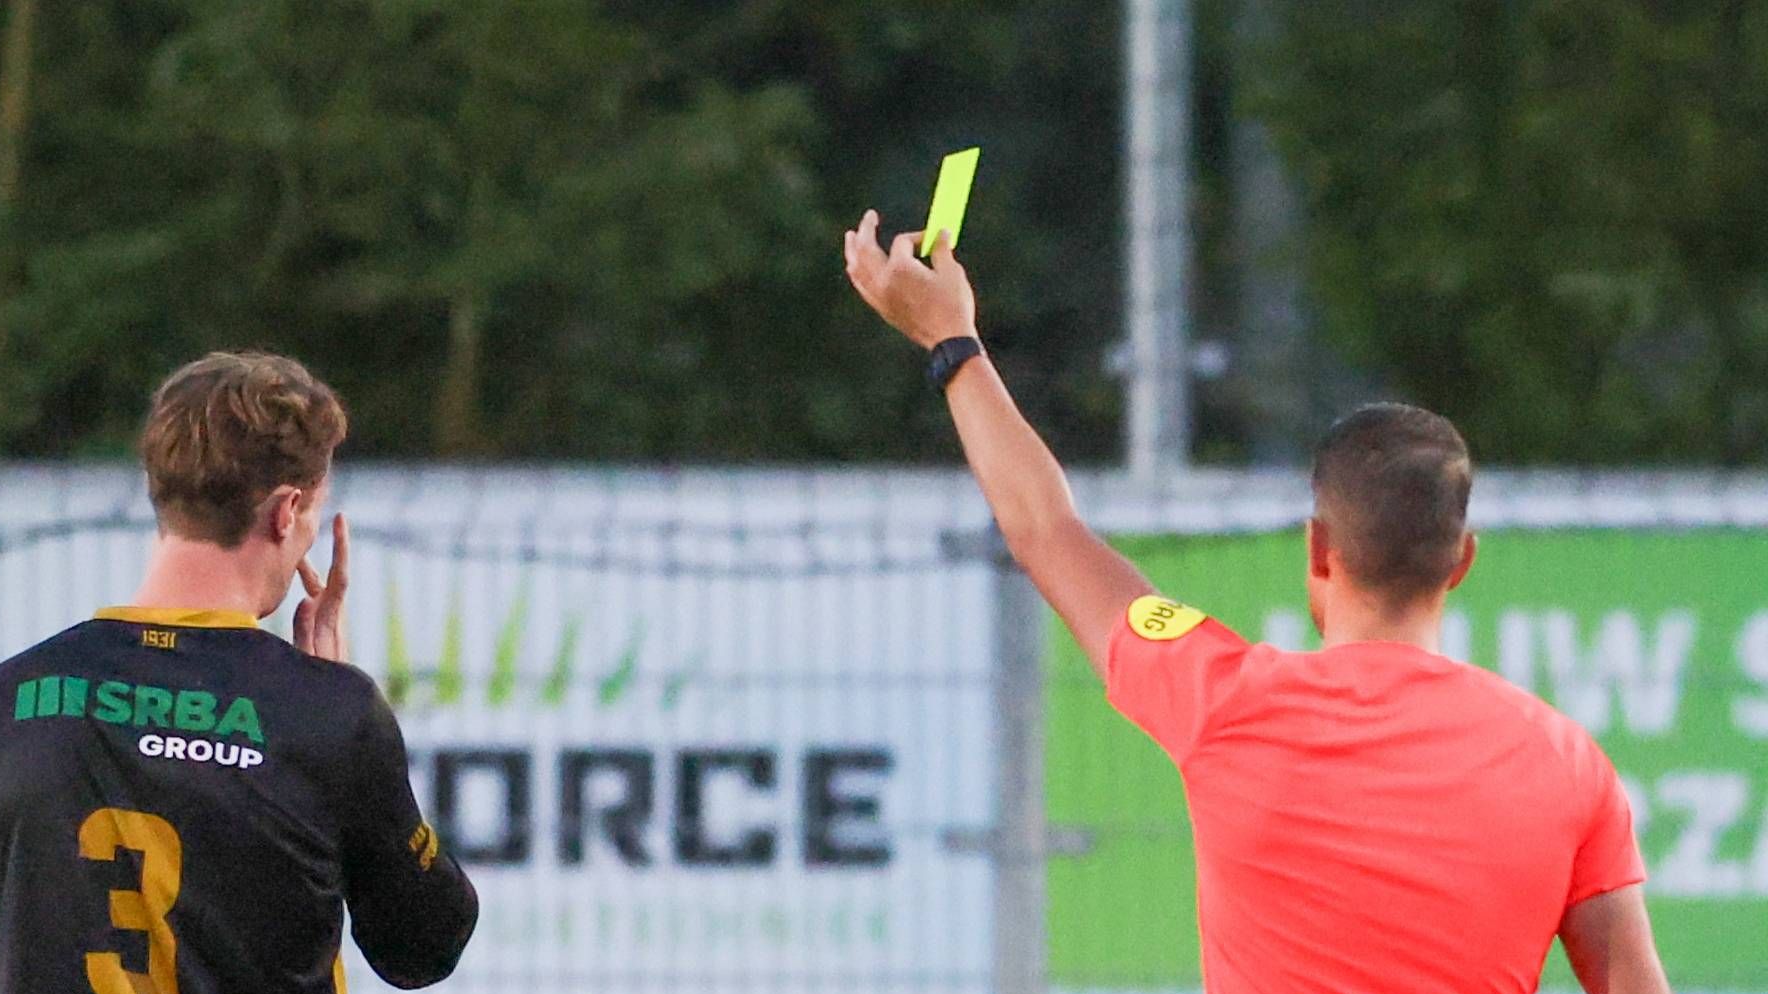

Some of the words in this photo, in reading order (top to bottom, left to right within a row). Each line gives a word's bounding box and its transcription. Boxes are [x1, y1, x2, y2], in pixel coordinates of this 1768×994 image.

[96, 680, 265, 743] SRBA
[138, 735, 264, 769] GROUP
[432, 745, 894, 868] ORCE
